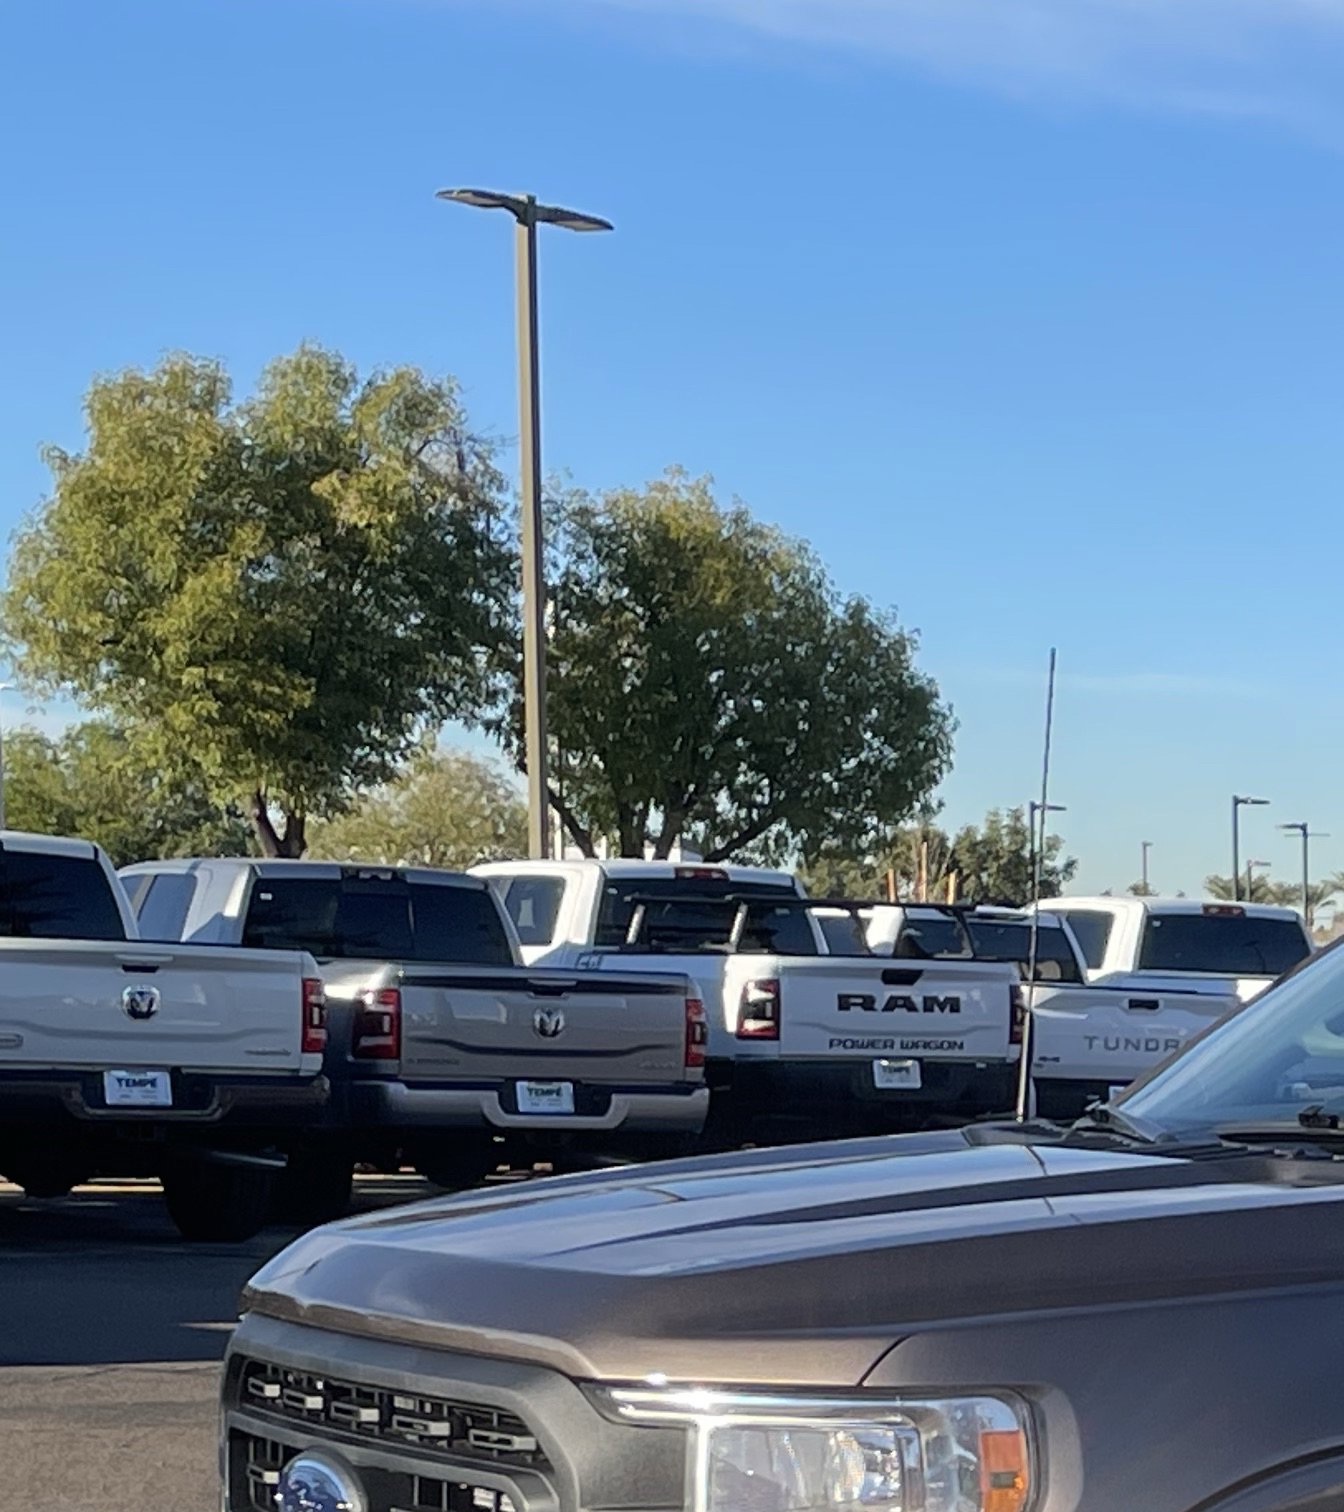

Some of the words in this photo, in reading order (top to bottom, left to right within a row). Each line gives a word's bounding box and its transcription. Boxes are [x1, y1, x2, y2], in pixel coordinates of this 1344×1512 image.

[837, 993, 961, 1014] RAM
[828, 1038, 895, 1050] POWER
[900, 1039, 965, 1051] WAGON
[1084, 1035, 1182, 1052] TUNDR
